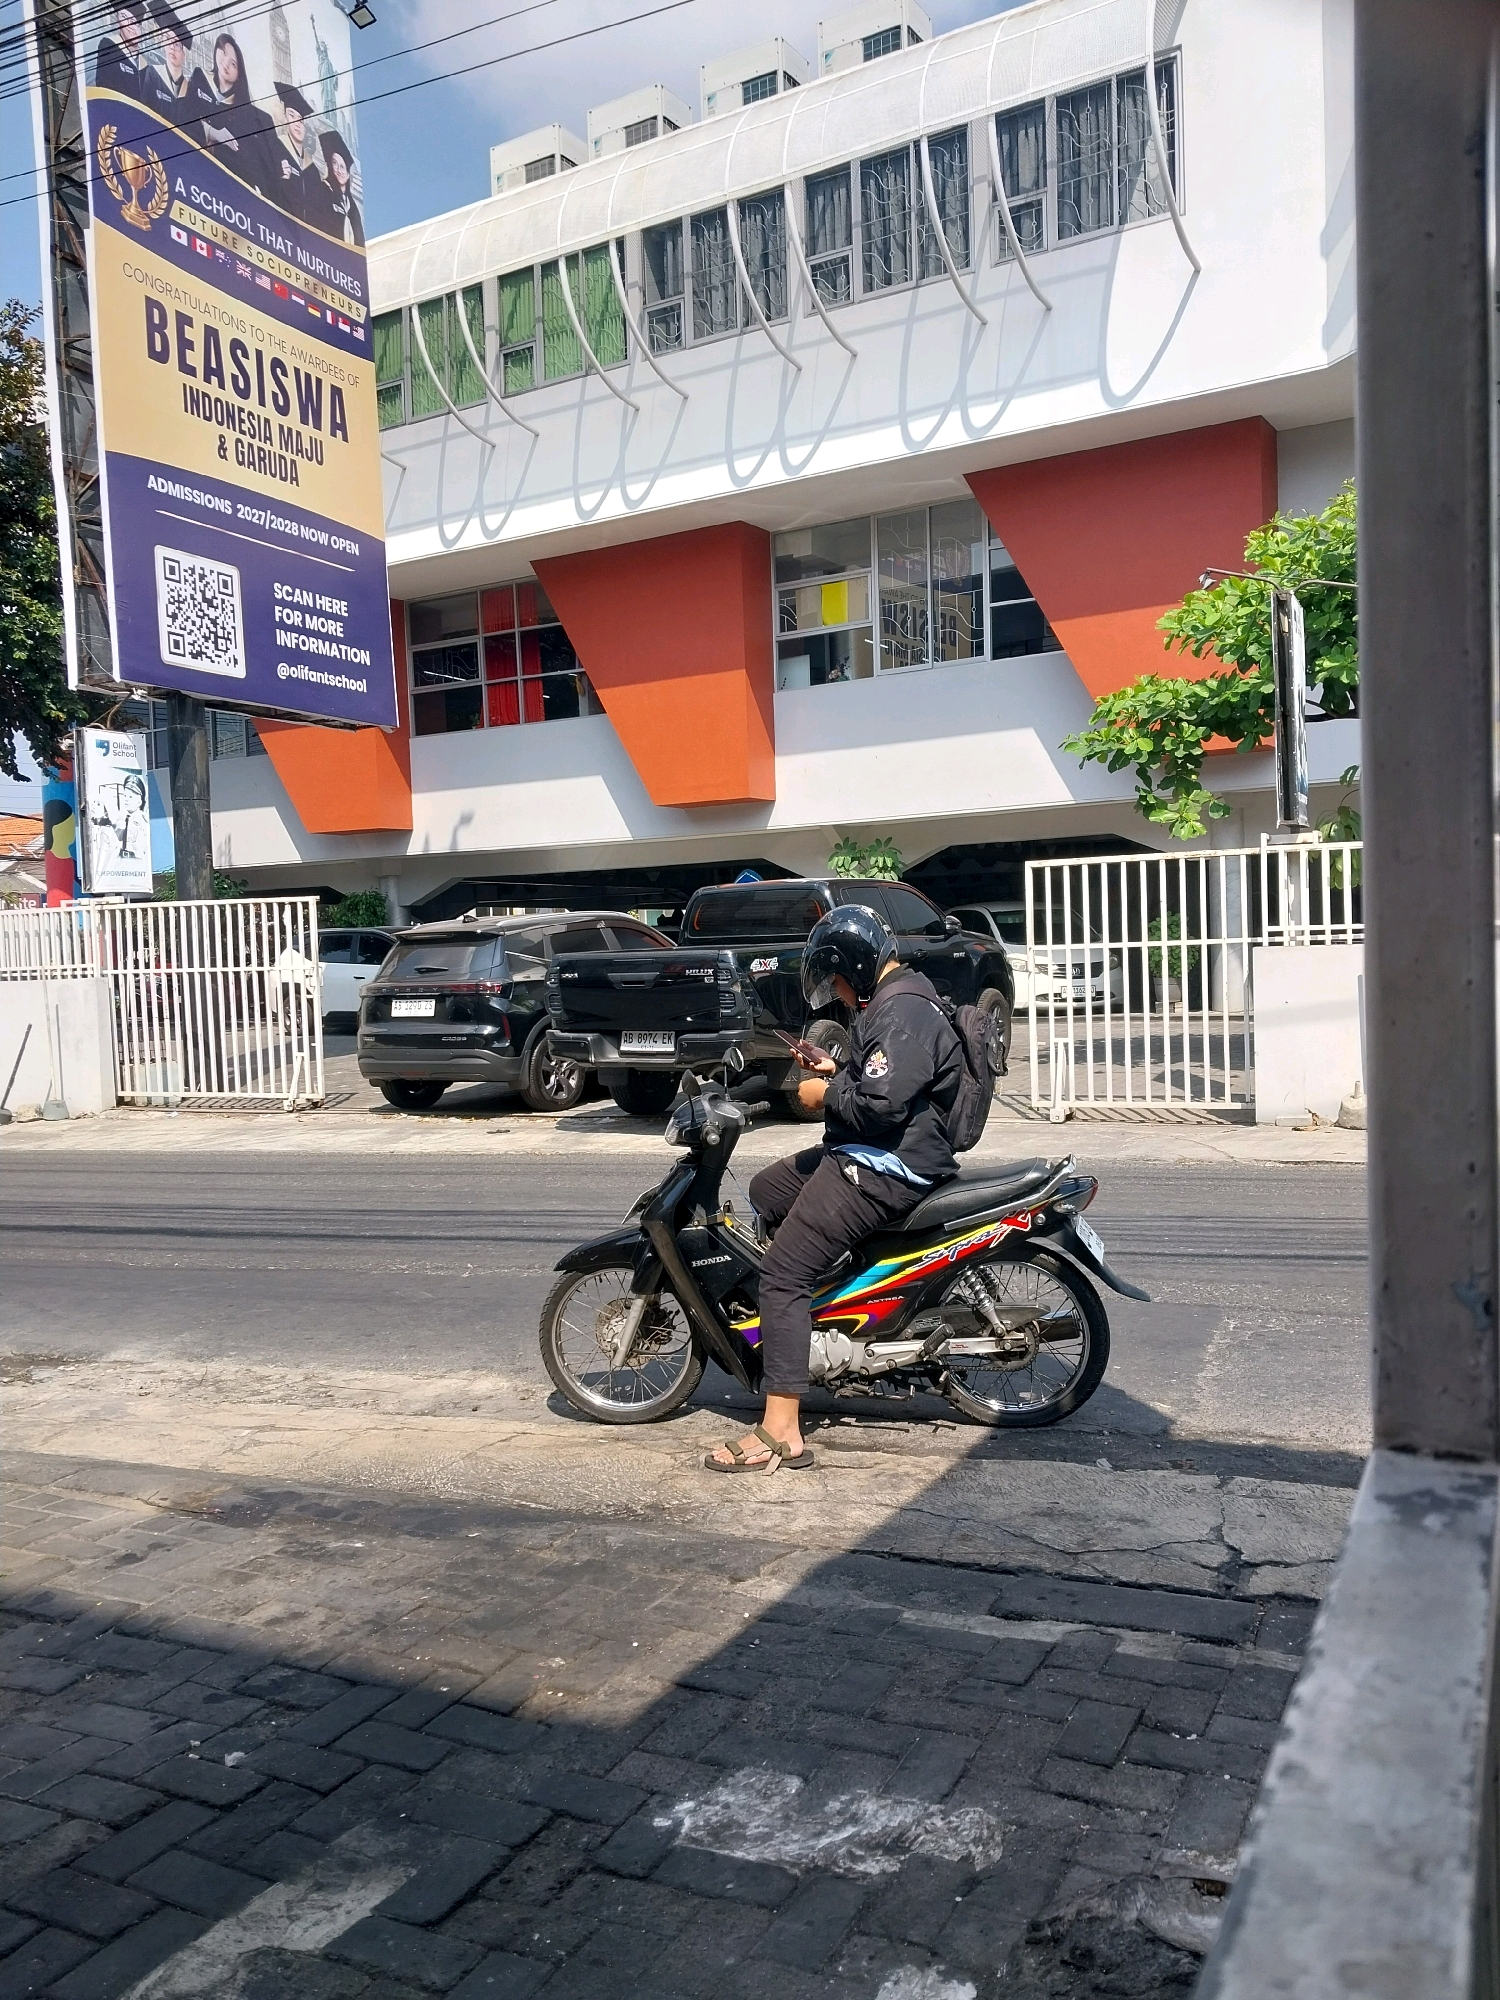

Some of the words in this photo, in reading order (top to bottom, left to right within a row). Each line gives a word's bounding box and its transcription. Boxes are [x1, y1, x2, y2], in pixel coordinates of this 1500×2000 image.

[175, 177, 187, 198] A
[190, 185, 255, 236] SCHOOL
[257, 223, 294, 257] THAT
[297, 246, 362, 297] NURTURES
[178, 206, 239, 250] FUTURE
[247, 245, 362, 318] SOCIOPRENEURS
[122, 262, 247, 334] CONGRATULATIONS
[249, 324, 265, 343] TO
[267, 332, 287, 354] THE
[290, 345, 346, 382] AWARDEES
[347, 373, 360, 389] OF
[144, 294, 350, 444] BEASISWA
[182, 382, 274, 447] INDONESIA
[278, 423, 325, 466] MAJU
[217, 433, 229, 462] &
[235, 437, 300, 487] GARUDA
[147, 474, 233, 515] ADMISSIONS
[236, 503, 299, 536] 2027/2028
[300, 526, 329, 547] NOW
[330, 536, 360, 556] OPEN
[273, 582, 314, 608] SCAN
[316, 594, 349, 617] HERE
[274, 605, 303, 628] FOR
[305, 615, 344, 638] MORE
[275, 628, 371, 666] INFORMATION
[277, 662, 368, 693] @olifantschool
[112, 741, 137, 751] Olifant
[112, 749, 137, 758] School
[685, 968, 714, 976] HILUX
[623, 1032, 634, 1044] AB
[637, 1032, 658, 1045] 8974
[662, 1032, 674, 1045] EK
[691, 1254, 732, 1268] HONDA
